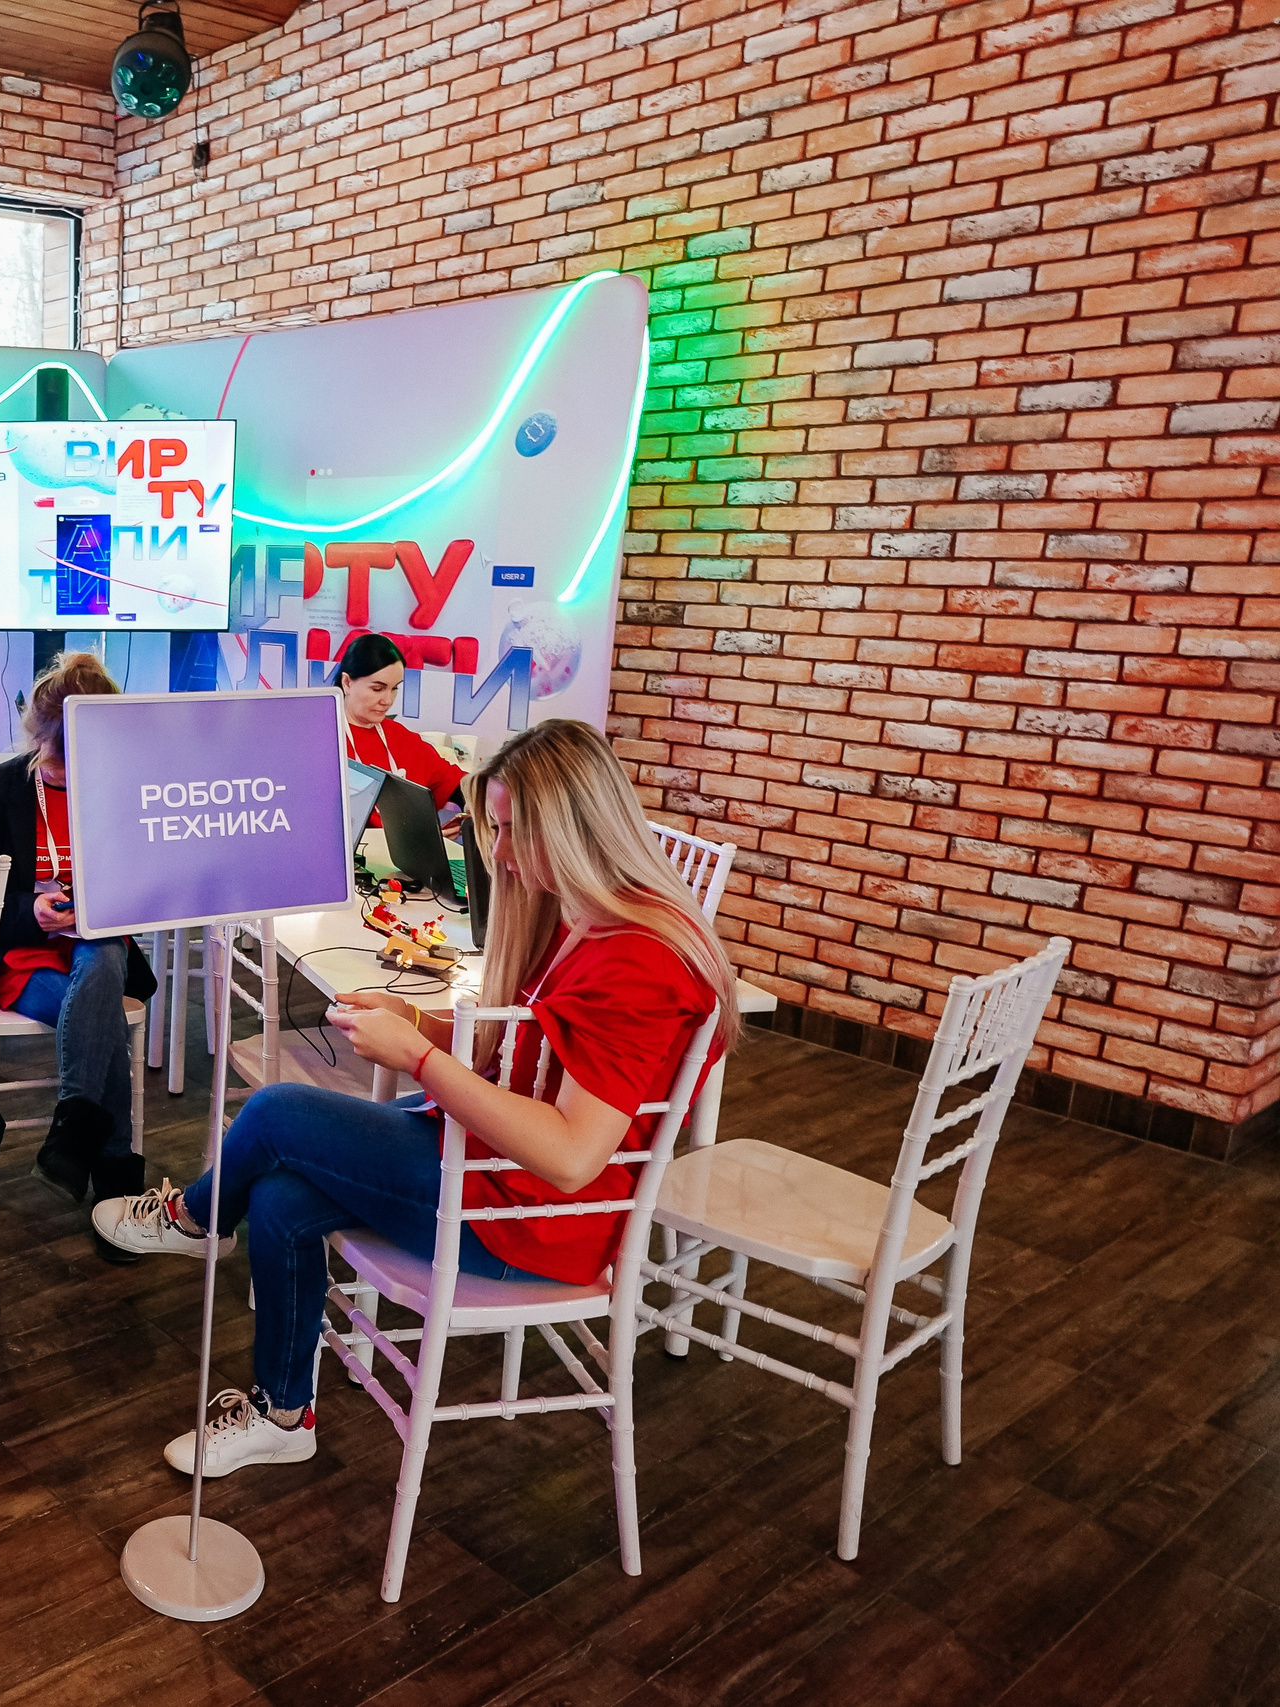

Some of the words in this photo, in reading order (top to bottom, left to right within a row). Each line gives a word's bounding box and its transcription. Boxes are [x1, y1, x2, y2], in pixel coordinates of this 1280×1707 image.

[65, 438, 188, 479] ВИР
[147, 479, 227, 519] ТУ
[140, 777, 286, 810] РОБОТО-
[139, 808, 291, 842] ТЕХНИКА
